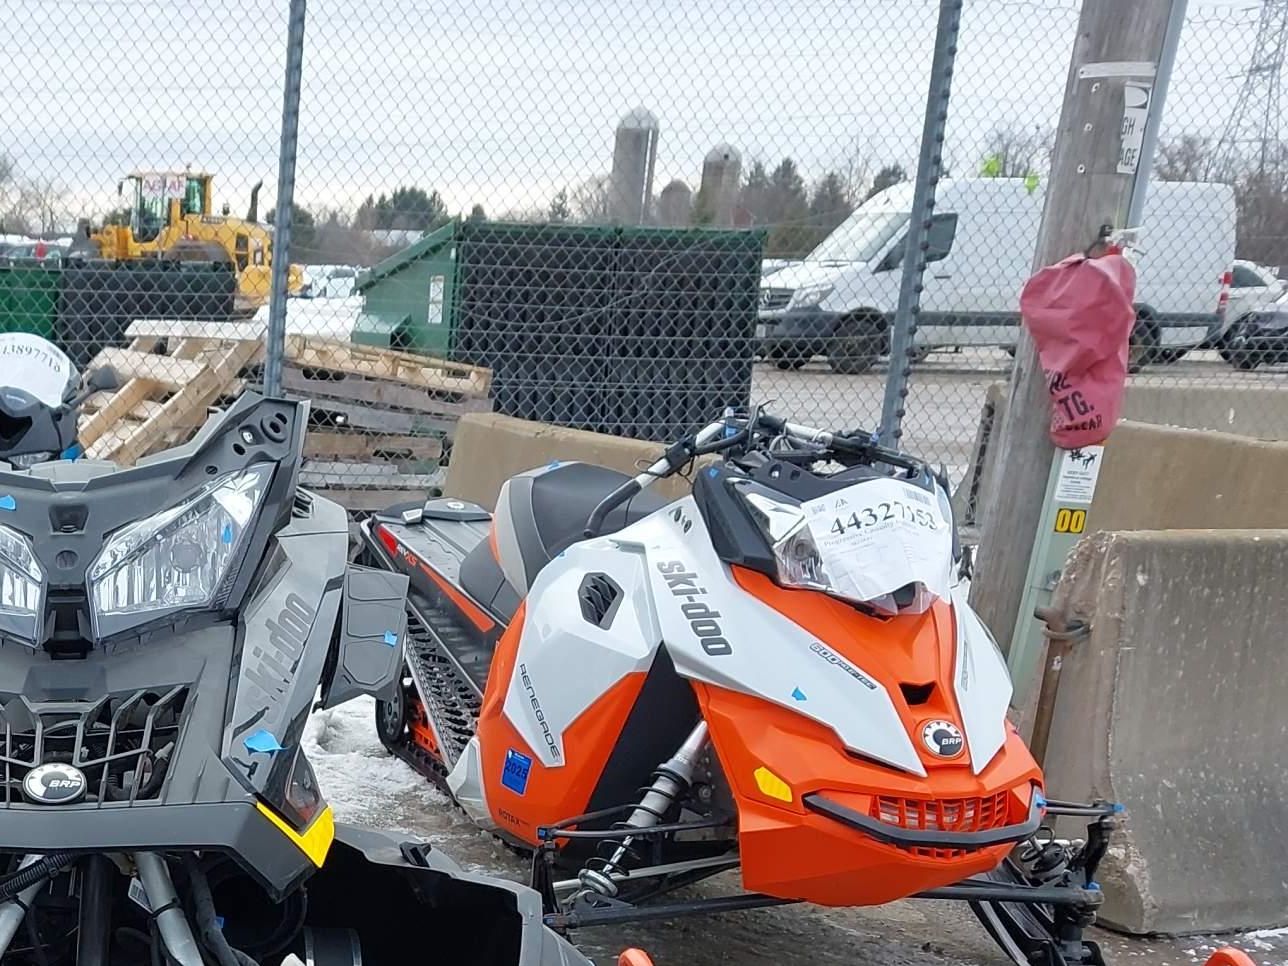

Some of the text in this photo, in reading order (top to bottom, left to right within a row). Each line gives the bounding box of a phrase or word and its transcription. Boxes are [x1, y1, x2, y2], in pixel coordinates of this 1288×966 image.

[830, 501, 938, 535] 44327153
[1055, 509, 1086, 532] 00
[657, 560, 733, 657] ski-doo
[520, 663, 561, 760] RENEGADE
[941, 737, 963, 746] BRP
[504, 760, 528, 780] 2025
[48, 779, 82, 788] BRP
